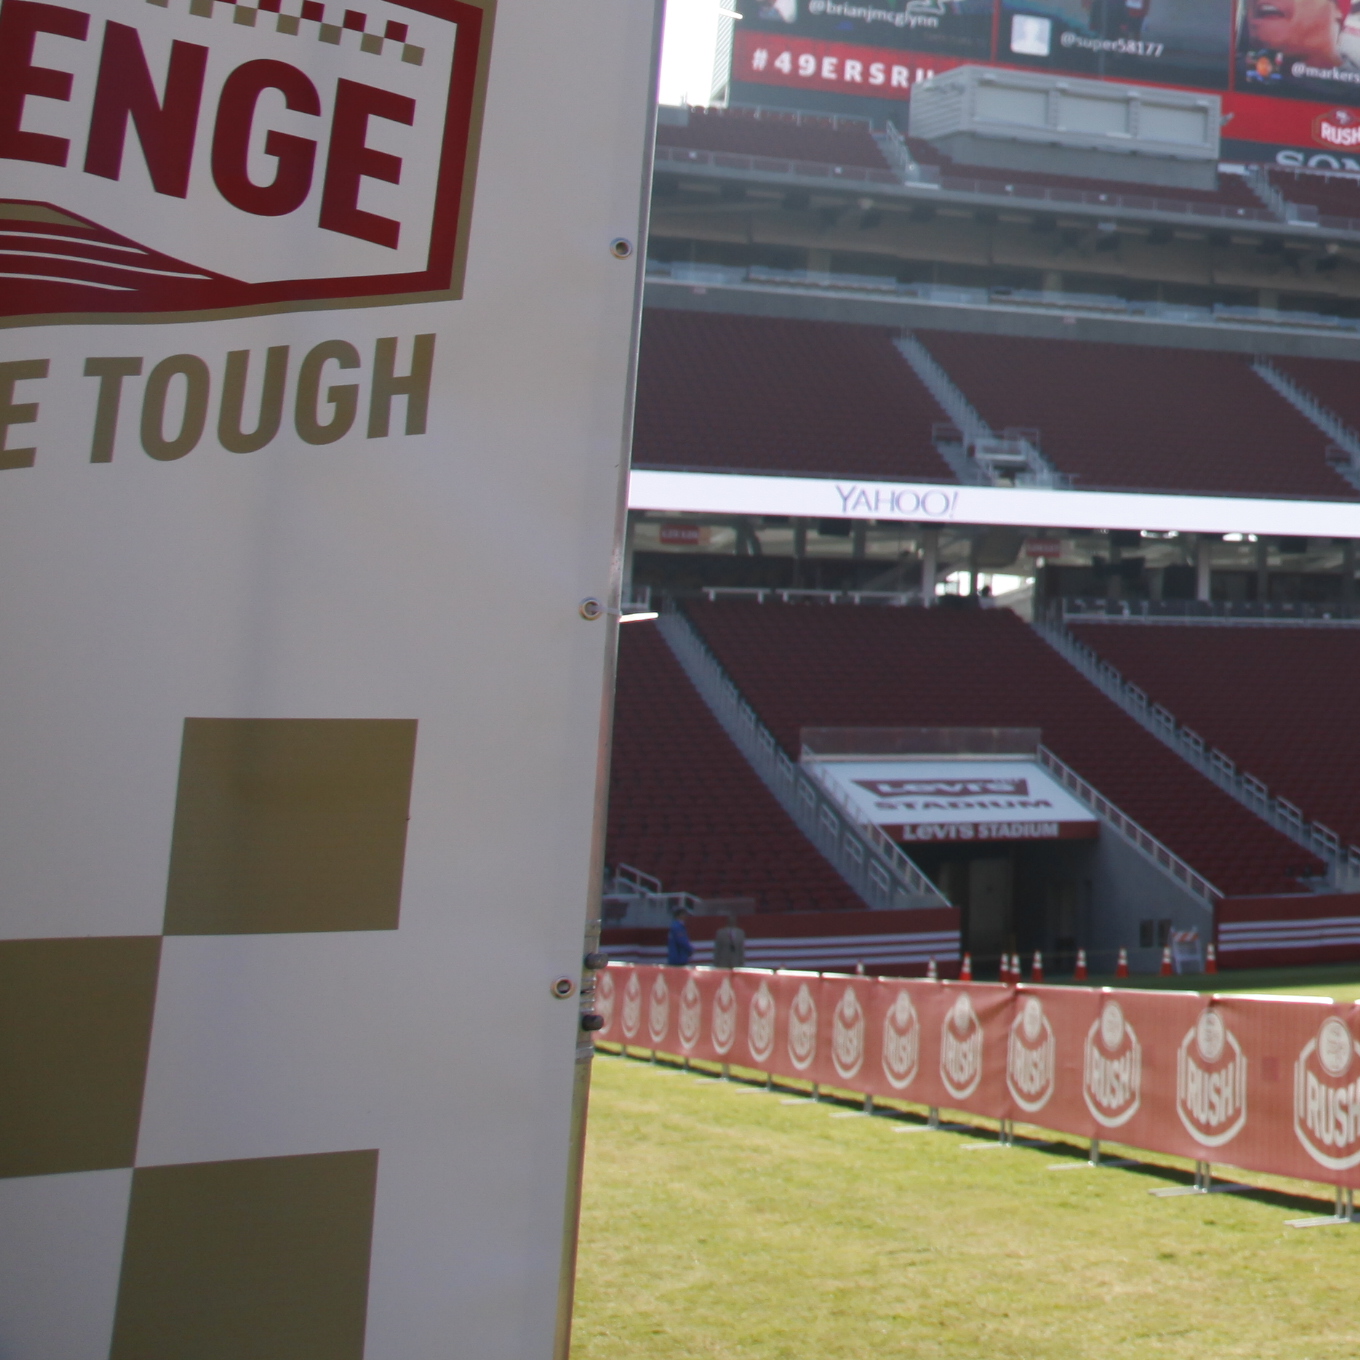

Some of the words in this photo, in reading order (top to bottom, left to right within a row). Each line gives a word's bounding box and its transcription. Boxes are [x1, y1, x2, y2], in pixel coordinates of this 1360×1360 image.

[1059, 29, 1164, 58] @super58177
[82, 332, 437, 464] TOUGH
[835, 484, 959, 519] YAHOO!
[874, 799, 1053, 810] STADIUM
[978, 822, 1060, 838] STADIUM
[1012, 1040, 1048, 1095] RUSH
[1090, 1043, 1131, 1110] RUSH
[1188, 1055, 1235, 1127] RUSH
